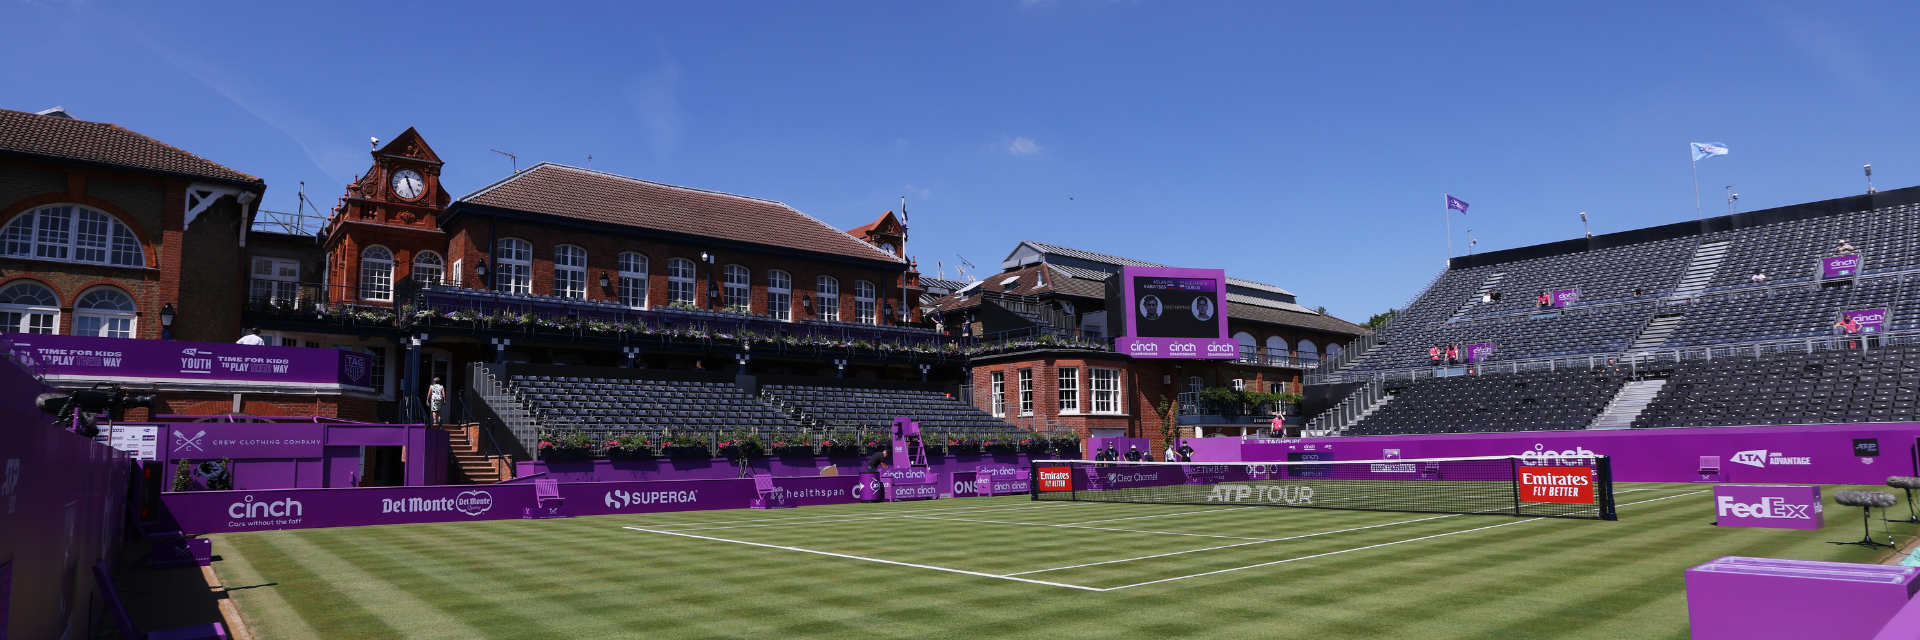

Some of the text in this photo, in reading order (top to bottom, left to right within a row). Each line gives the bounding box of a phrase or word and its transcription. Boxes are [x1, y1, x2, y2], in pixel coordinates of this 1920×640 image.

[1831, 259, 1856, 267] cinch
[1853, 314, 1882, 322] cinch
[1130, 340, 1158, 352] cinch
[1170, 341, 1196, 352] cinch
[1208, 341, 1234, 352] cinch
[52, 356, 74, 366] PLAY
[103, 357, 122, 367] WAY
[181, 358, 212, 369] YOUTH
[347, 357, 363, 366] TAG
[230, 363, 249, 371] PLAY
[273, 365, 288, 373] WAY
[1521, 443, 1597, 466] cinch
[1770, 457, 1811, 465] ADVANTAGE
[906, 469, 925, 478] cinch
[1000, 467, 1016, 475] cinch
[1040, 471, 1070, 480] Emirates
[1118, 472, 1158, 482] Clear Channel
[1522, 472, 1588, 486] Emirates
[896, 485, 936, 495] cinch cinch
[994, 481, 1027, 491] cinch cinch
[1533, 486, 1579, 497] FLY BETTER
[632, 490, 696, 504] SUPERGA
[787, 489, 844, 498] healthspan
[1207, 485, 1314, 504] ATP TOUR
[228, 495, 302, 518] cinch
[382, 497, 455, 513] Del Monte
[1718, 496, 1811, 519] FedEx
